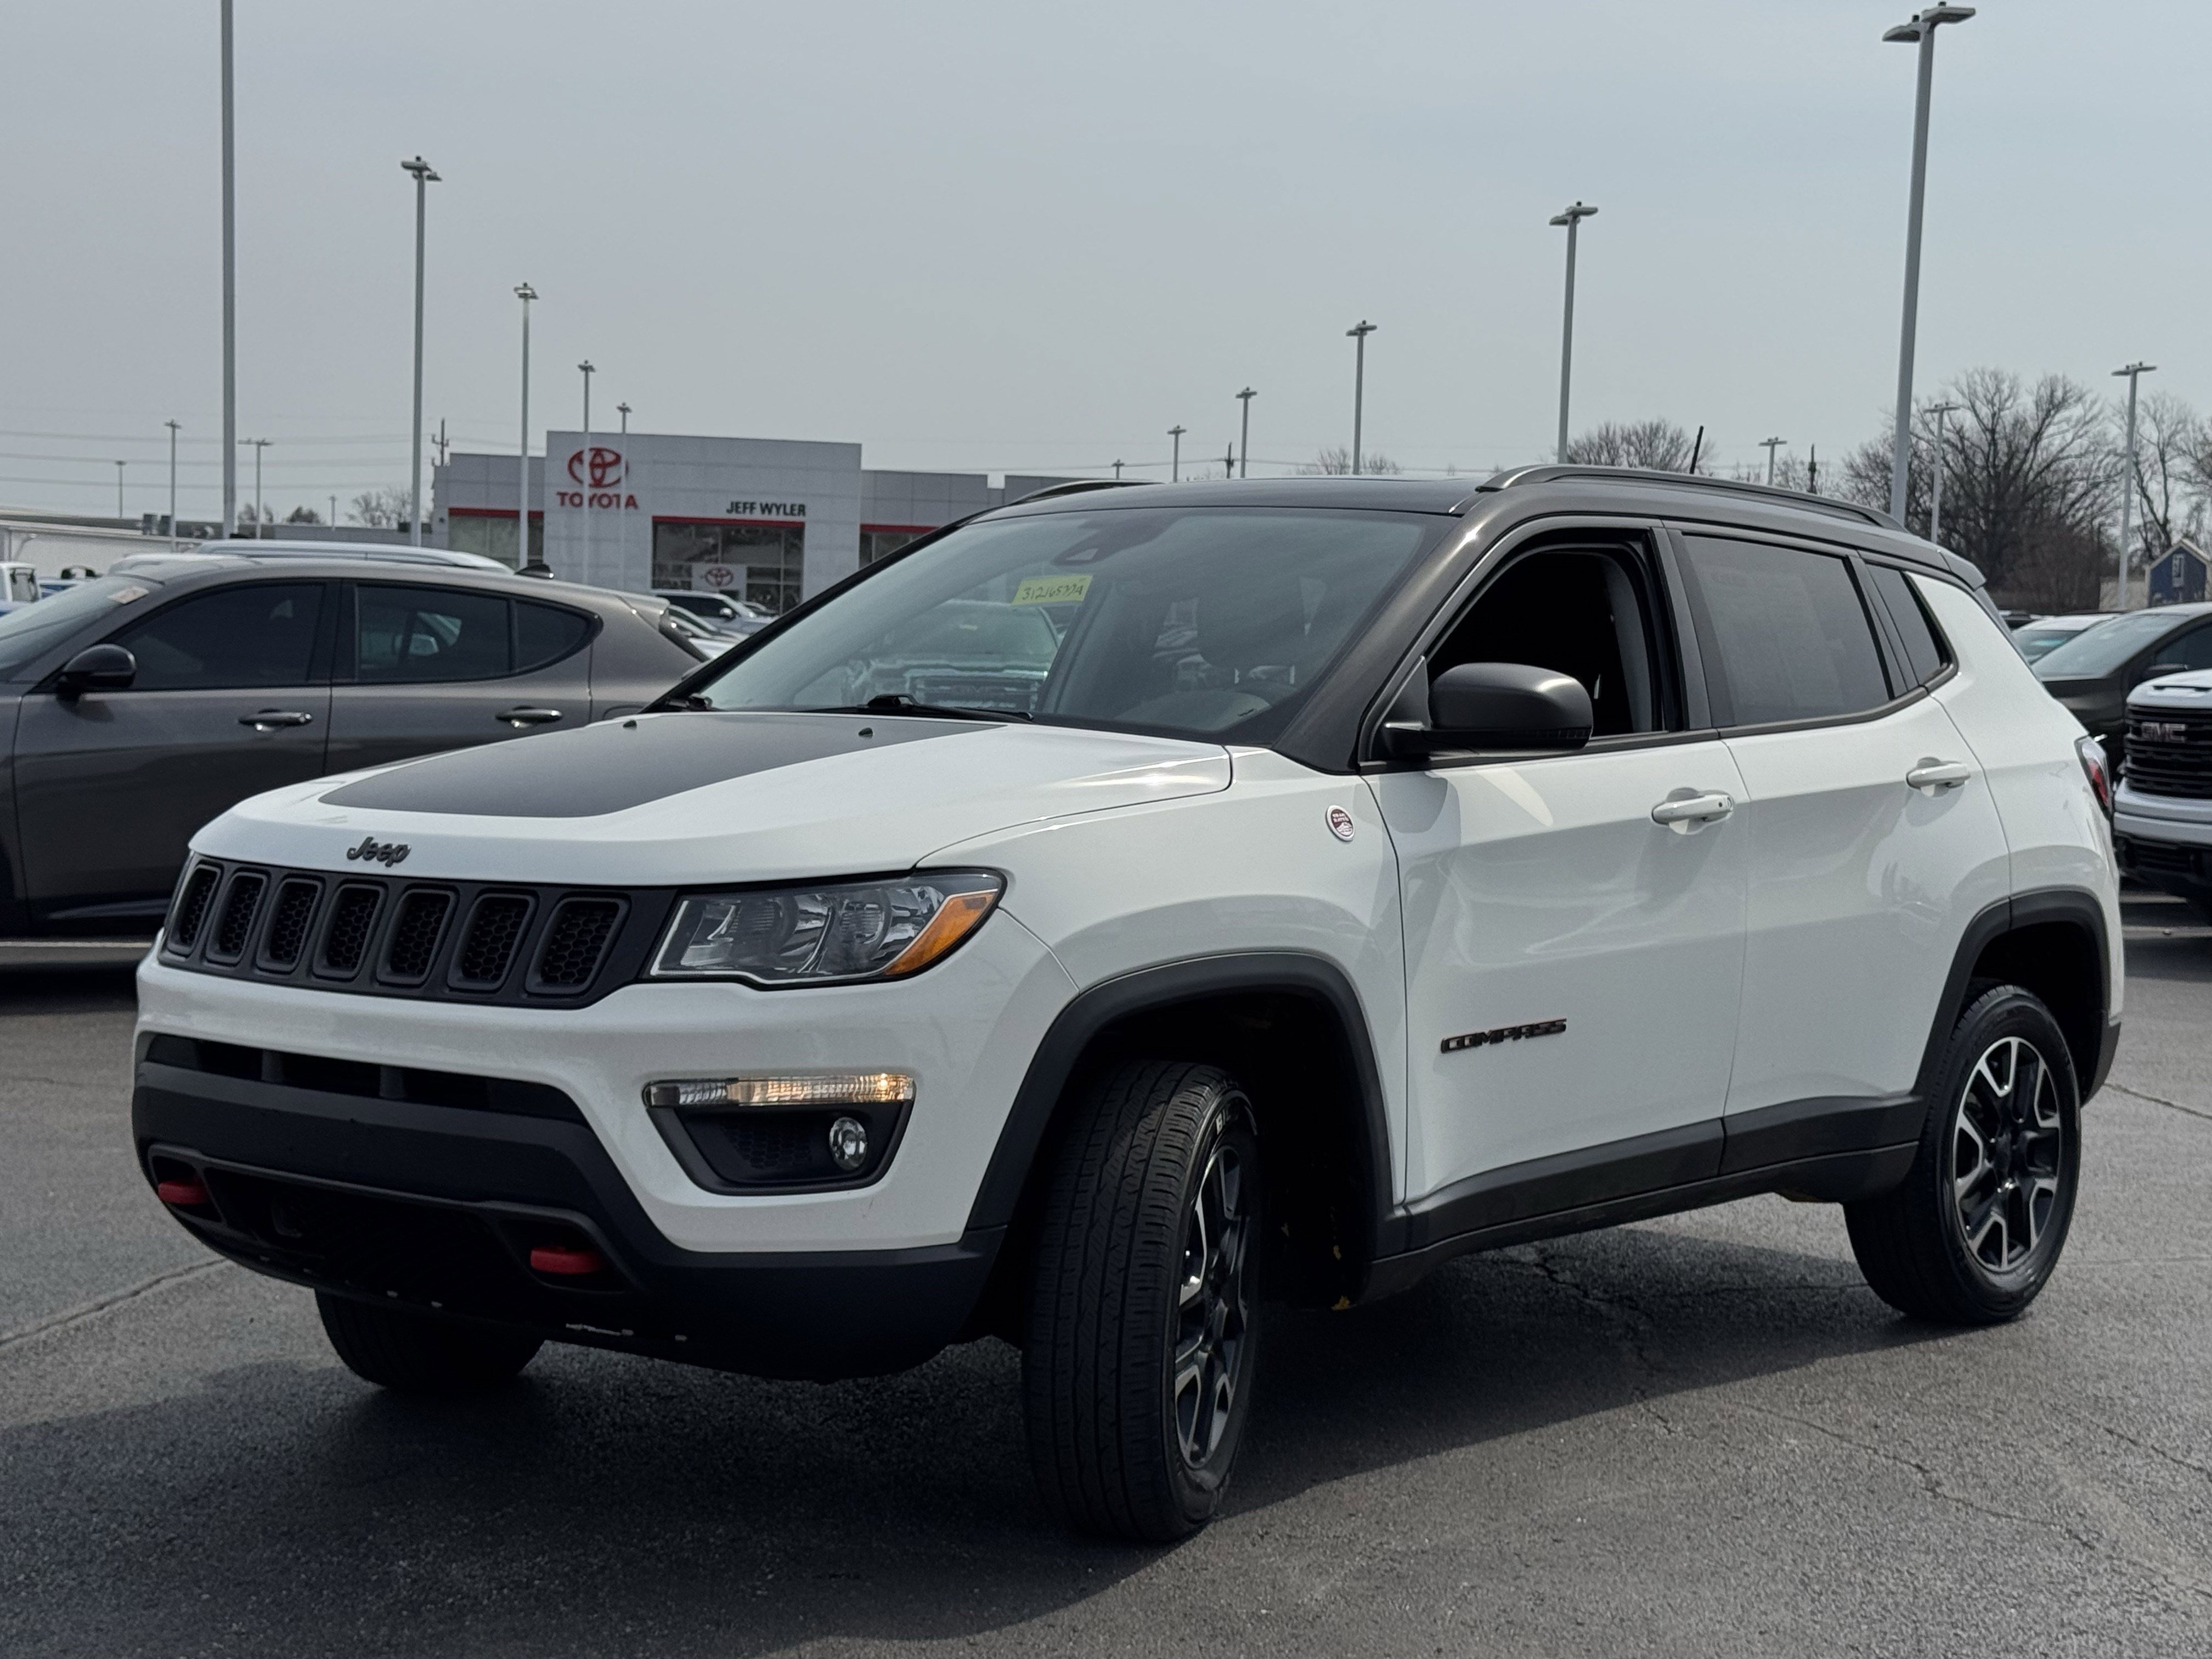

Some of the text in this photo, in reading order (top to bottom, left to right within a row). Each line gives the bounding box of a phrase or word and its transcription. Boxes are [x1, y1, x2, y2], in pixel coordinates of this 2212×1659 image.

[556, 492, 638, 510] TOYOTA
[726, 501, 806, 517] JEFF WYLER
[2141, 722, 2186, 743] GMC
[347, 836, 411, 867] Jeep
[1441, 1018, 1567, 1053] COMPASS
